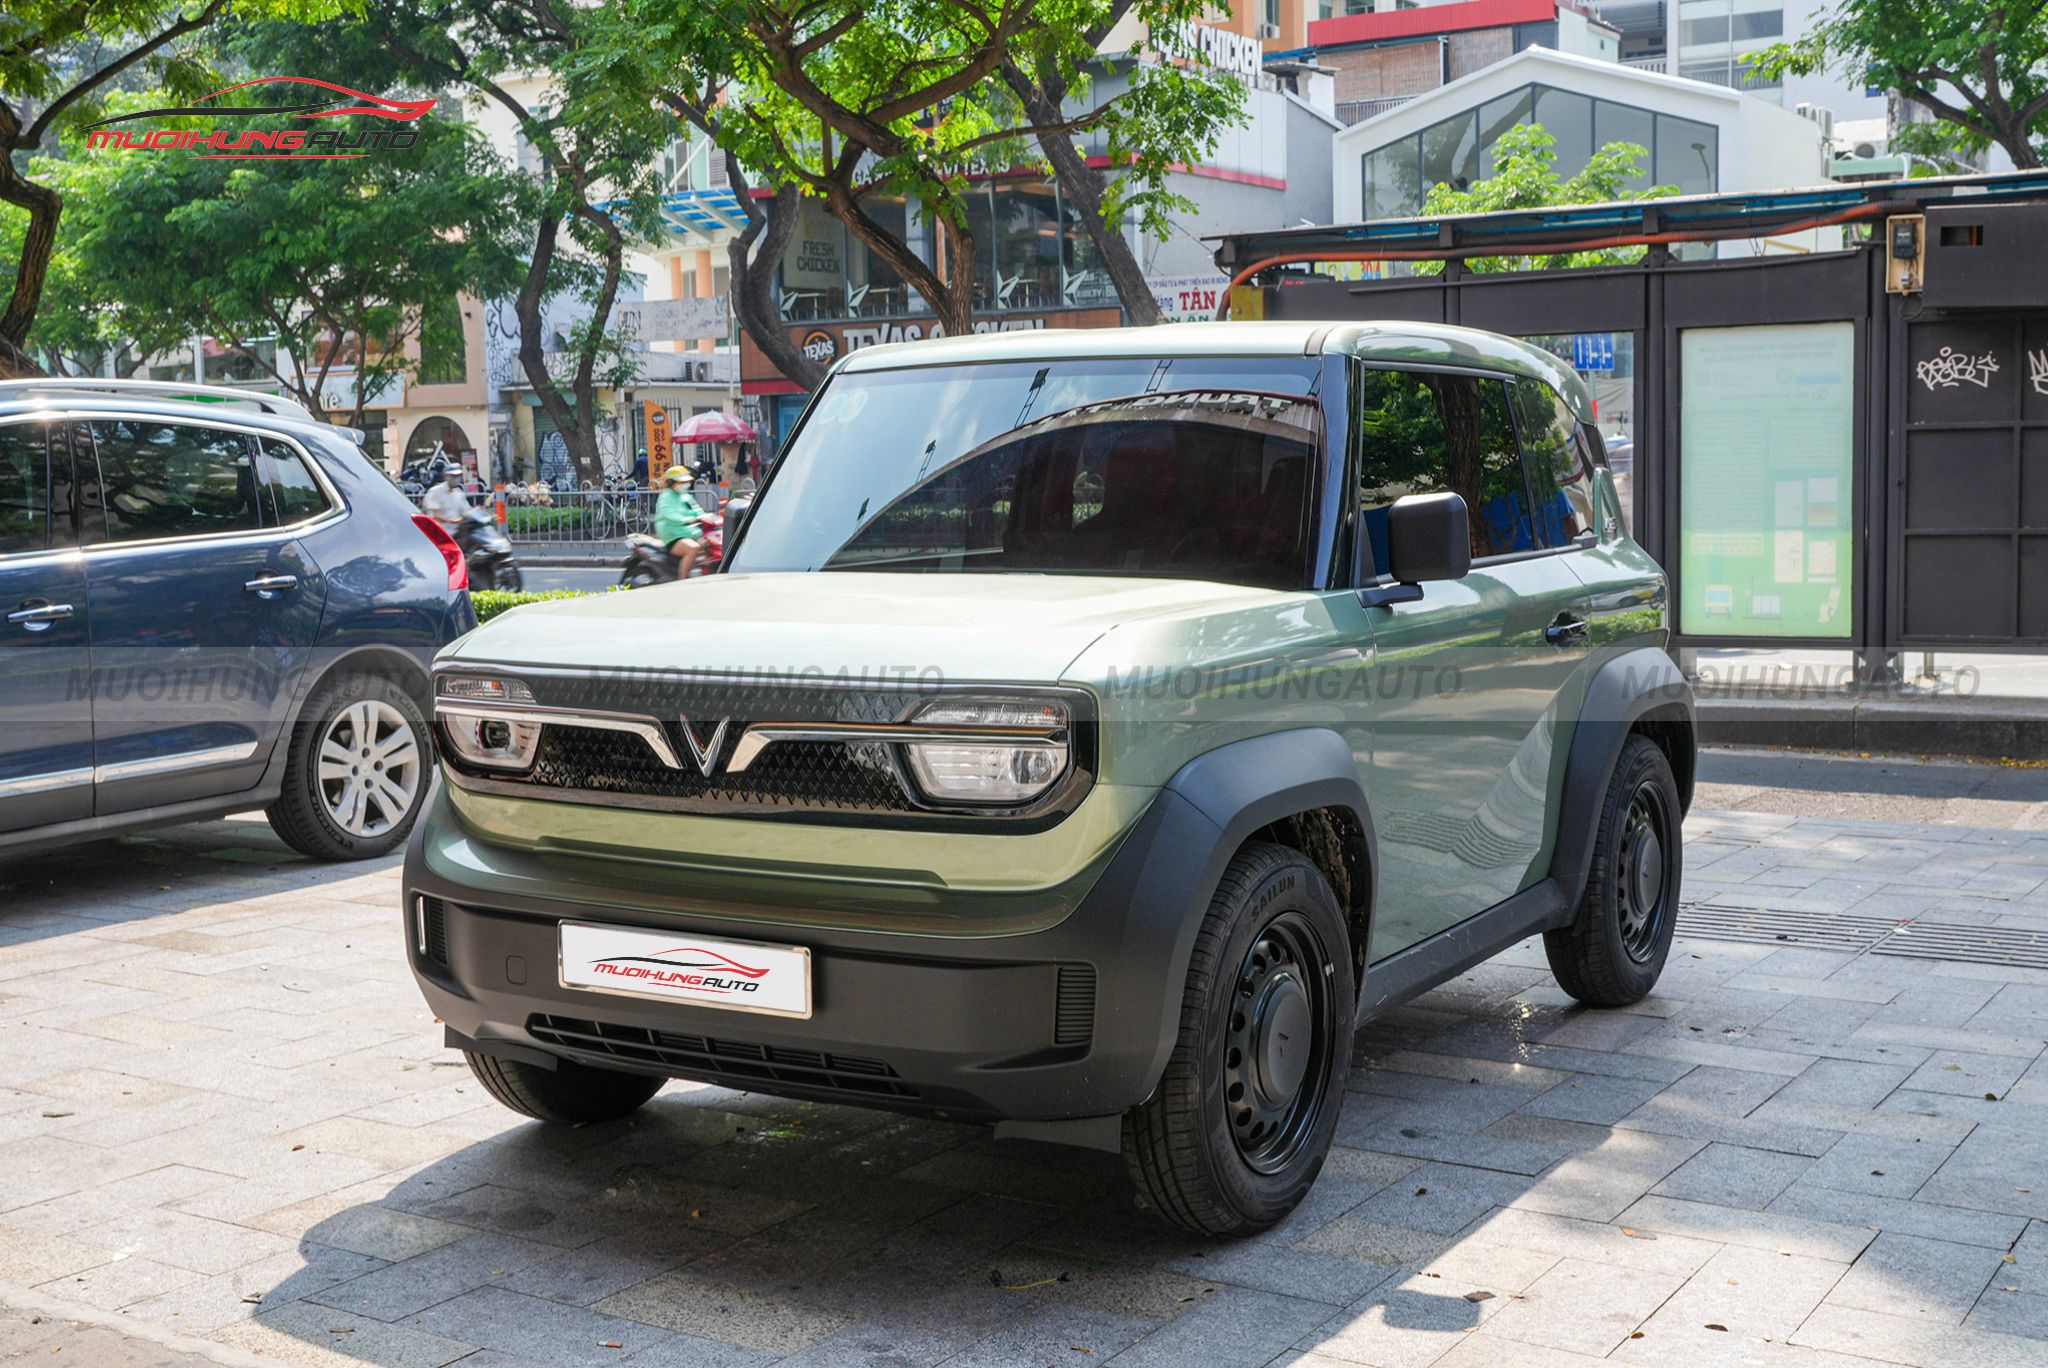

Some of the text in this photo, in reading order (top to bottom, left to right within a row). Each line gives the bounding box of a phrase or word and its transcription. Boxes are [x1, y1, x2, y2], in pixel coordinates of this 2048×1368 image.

[1200, 25, 1263, 76] CHICKEN
[803, 240, 835, 257] FRESH
[797, 255, 840, 273] CHICKEN
[1179, 287, 1216, 311] TÂN
[803, 340, 834, 361] TEXAS
[1252, 875, 1295, 918] SAILUN
